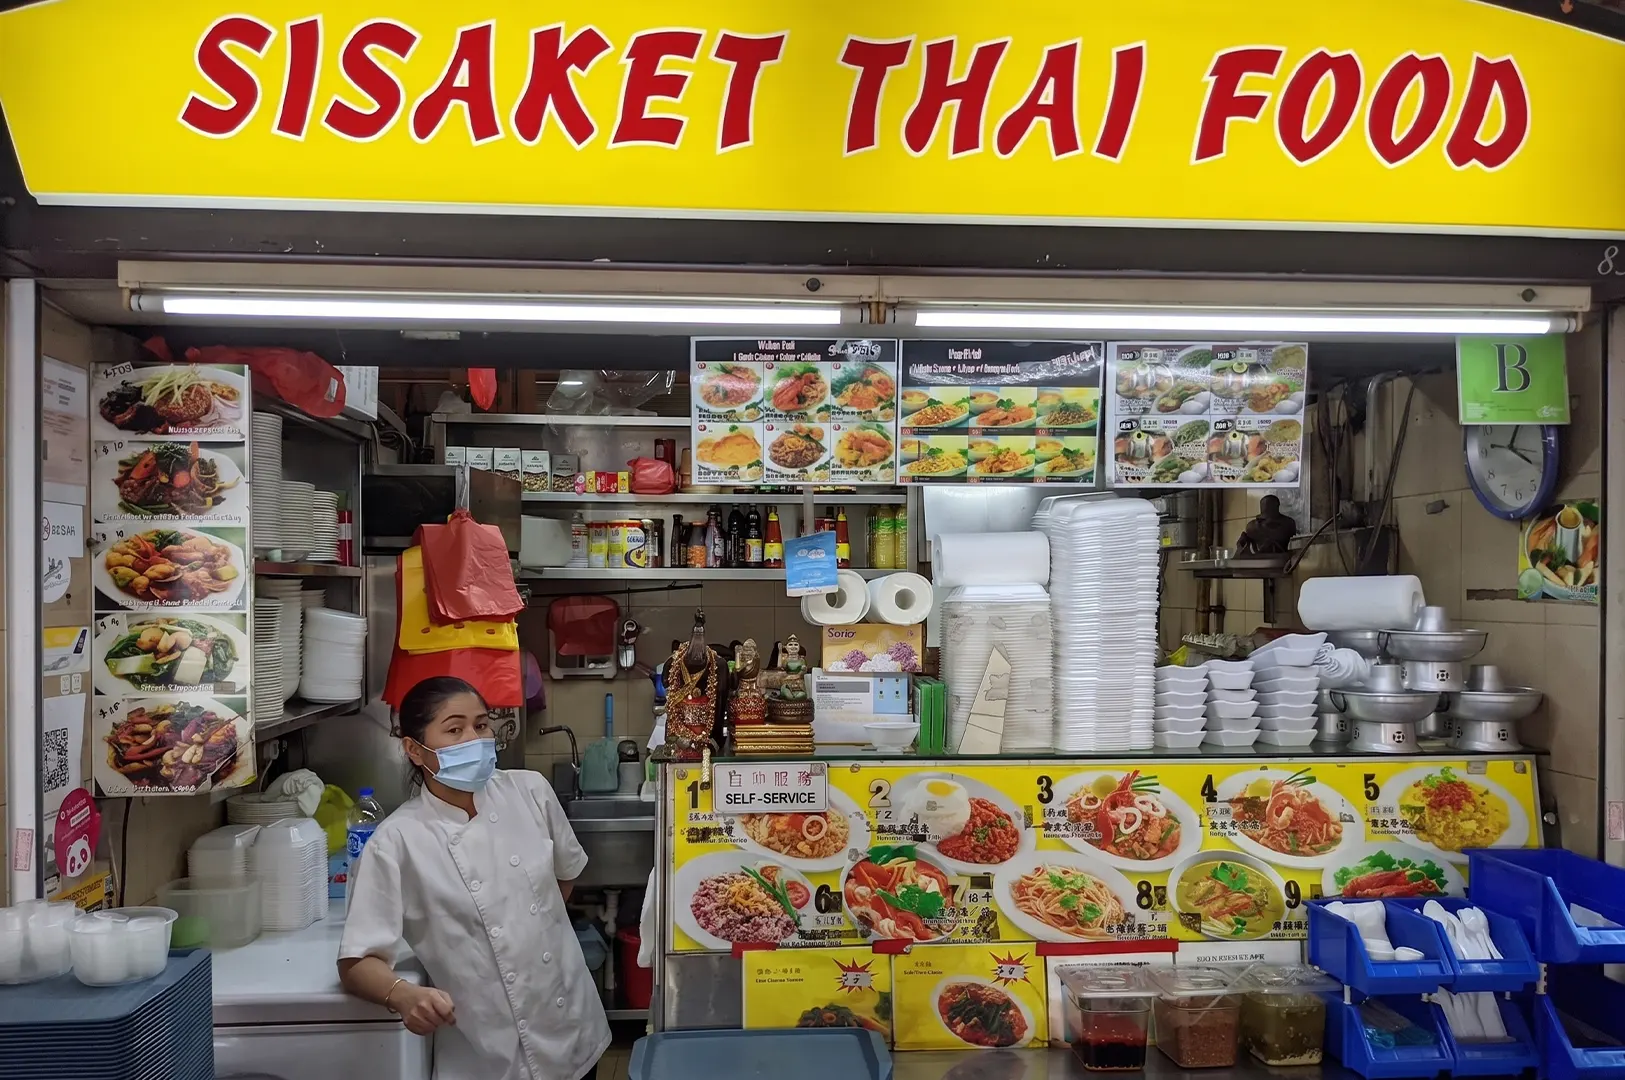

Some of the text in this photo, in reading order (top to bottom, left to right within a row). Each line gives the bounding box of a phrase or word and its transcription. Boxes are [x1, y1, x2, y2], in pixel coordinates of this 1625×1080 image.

[178, 14, 1531, 171] SISAKET THAI FOOD
[1597, 245, 1625, 275] 8
[1492, 343, 1531, 392] B
[687, 780, 699, 809] 1
[725, 792, 816, 805] SELF-SERVICE
[868, 778, 892, 808] 2
[1036, 775, 1054, 804] 3
[1200, 774, 1218, 803] 4
[1363, 773, 1380, 801] 5
[814, 884, 831, 914] 6
[1136, 880, 1153, 910] 8
[1284, 880, 1301, 910] 9
